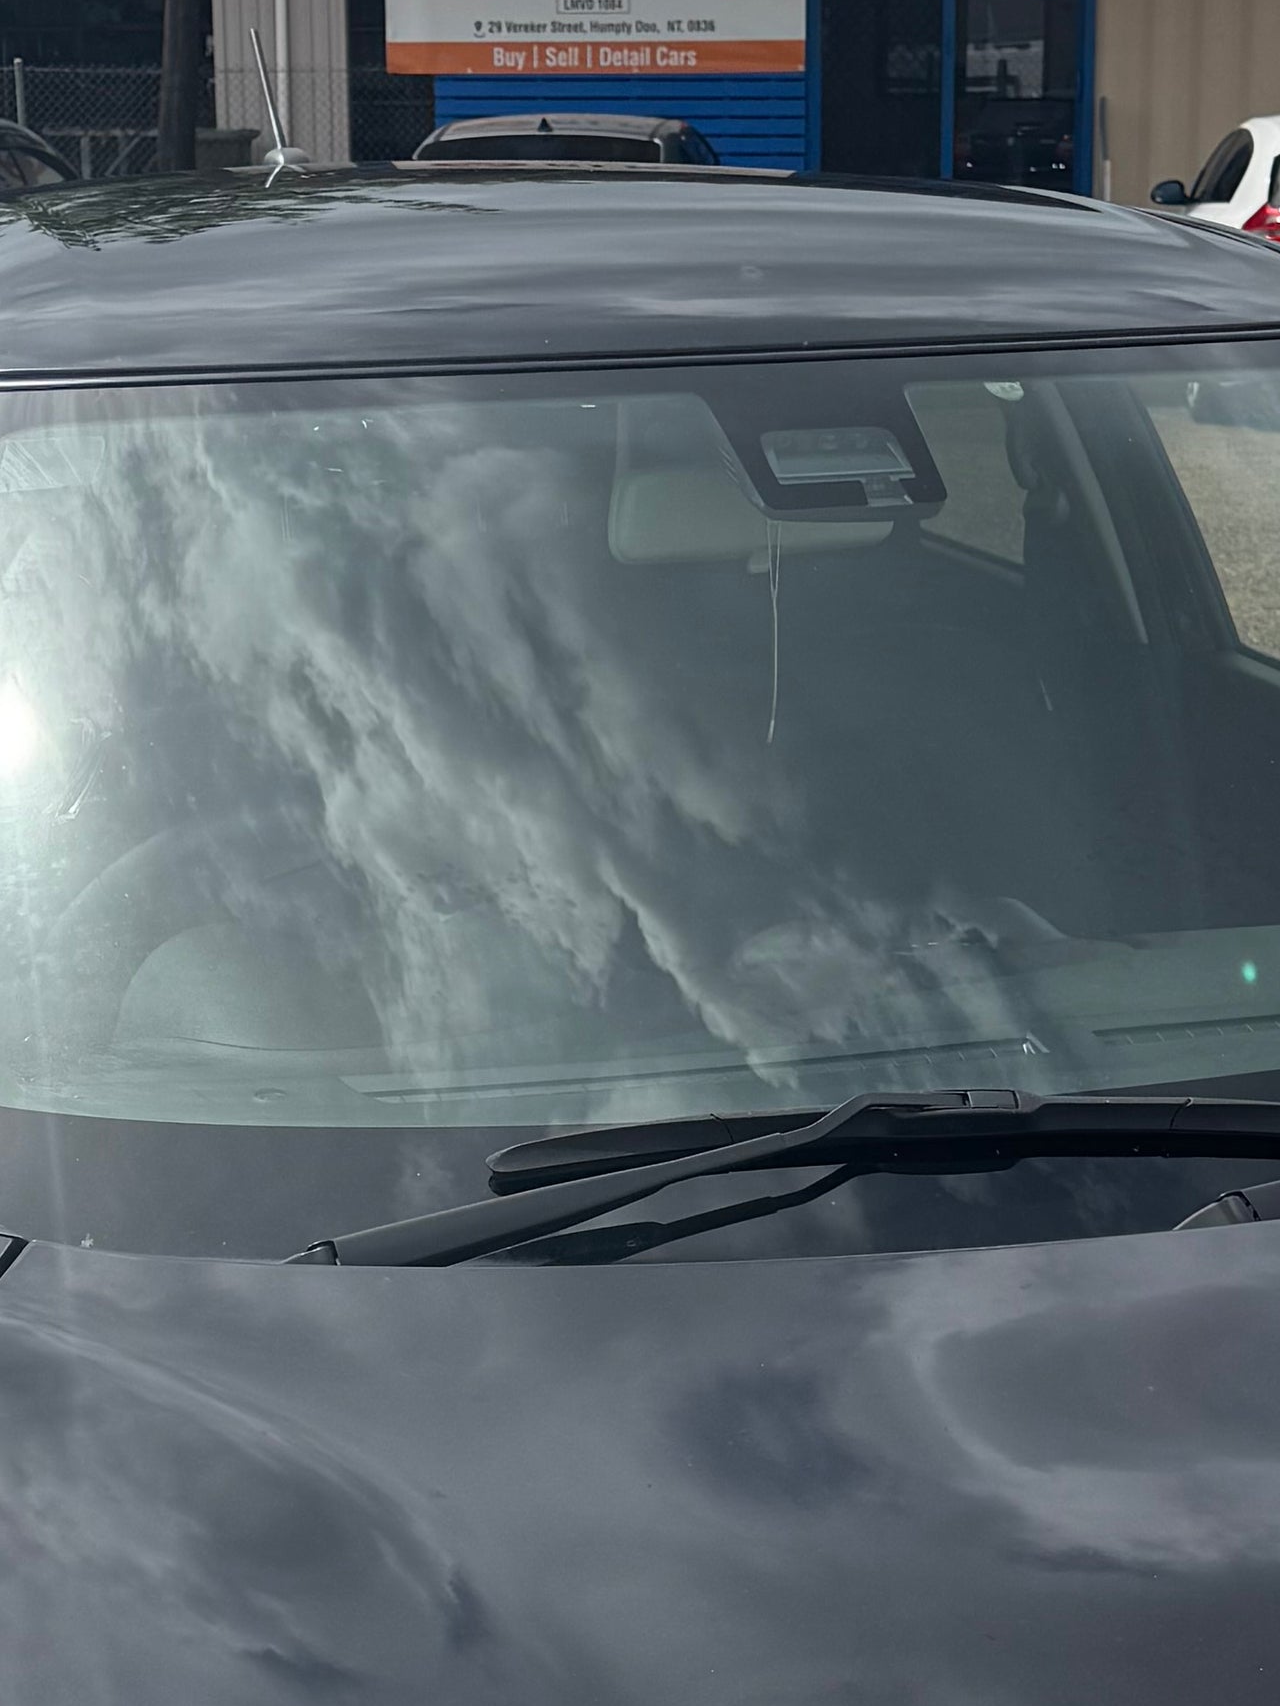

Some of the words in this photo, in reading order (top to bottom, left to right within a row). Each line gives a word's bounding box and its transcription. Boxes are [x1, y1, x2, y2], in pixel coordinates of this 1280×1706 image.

[504, 21, 548, 33] Vereker
[550, 21, 588, 34] Street,
[589, 20, 632, 36] Humpty
[635, 20, 660, 34] Doo,
[493, 46, 526, 71] Buy
[545, 46, 579, 67] Sell
[599, 46, 651, 67] Detail
[656, 45, 697, 67] Cars
